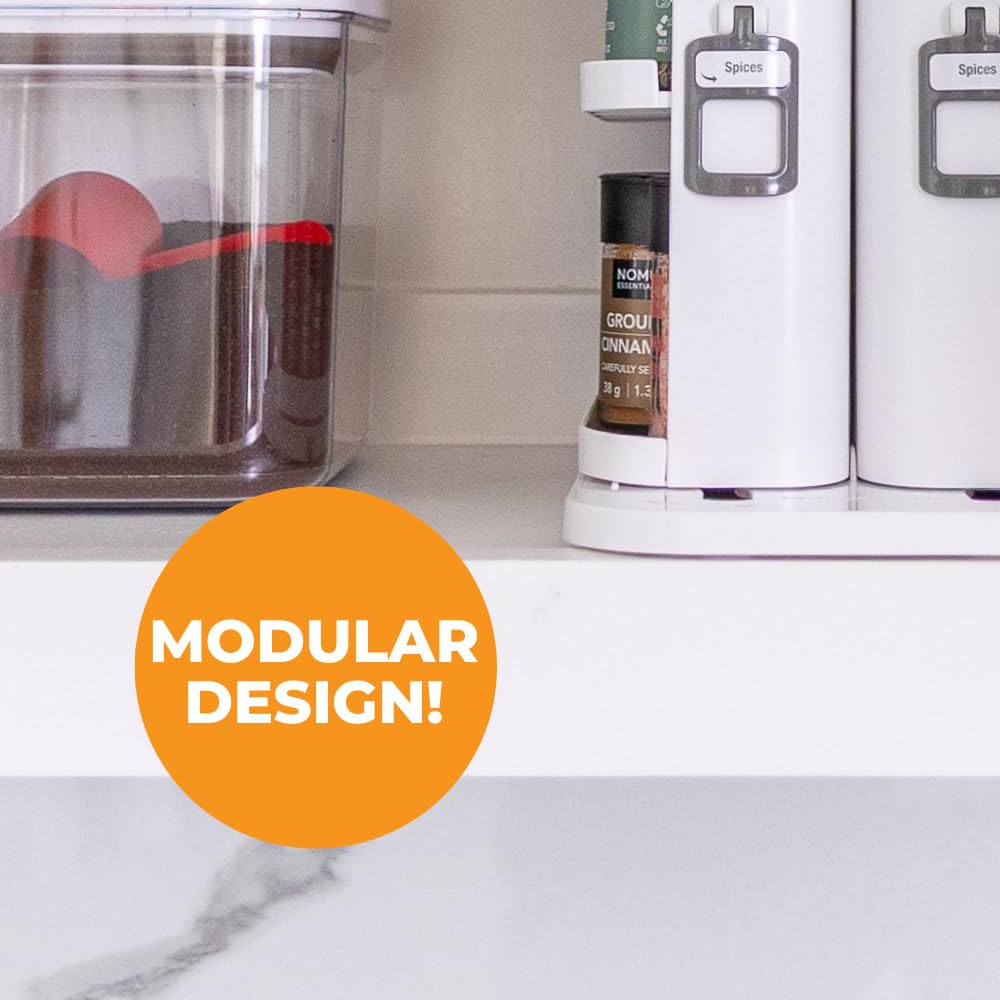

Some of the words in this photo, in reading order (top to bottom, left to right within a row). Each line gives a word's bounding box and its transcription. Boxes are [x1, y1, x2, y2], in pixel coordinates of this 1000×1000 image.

[724, 60, 764, 75] Spices
[957, 62, 998, 77] Spices
[616, 268, 652, 281] NOM
